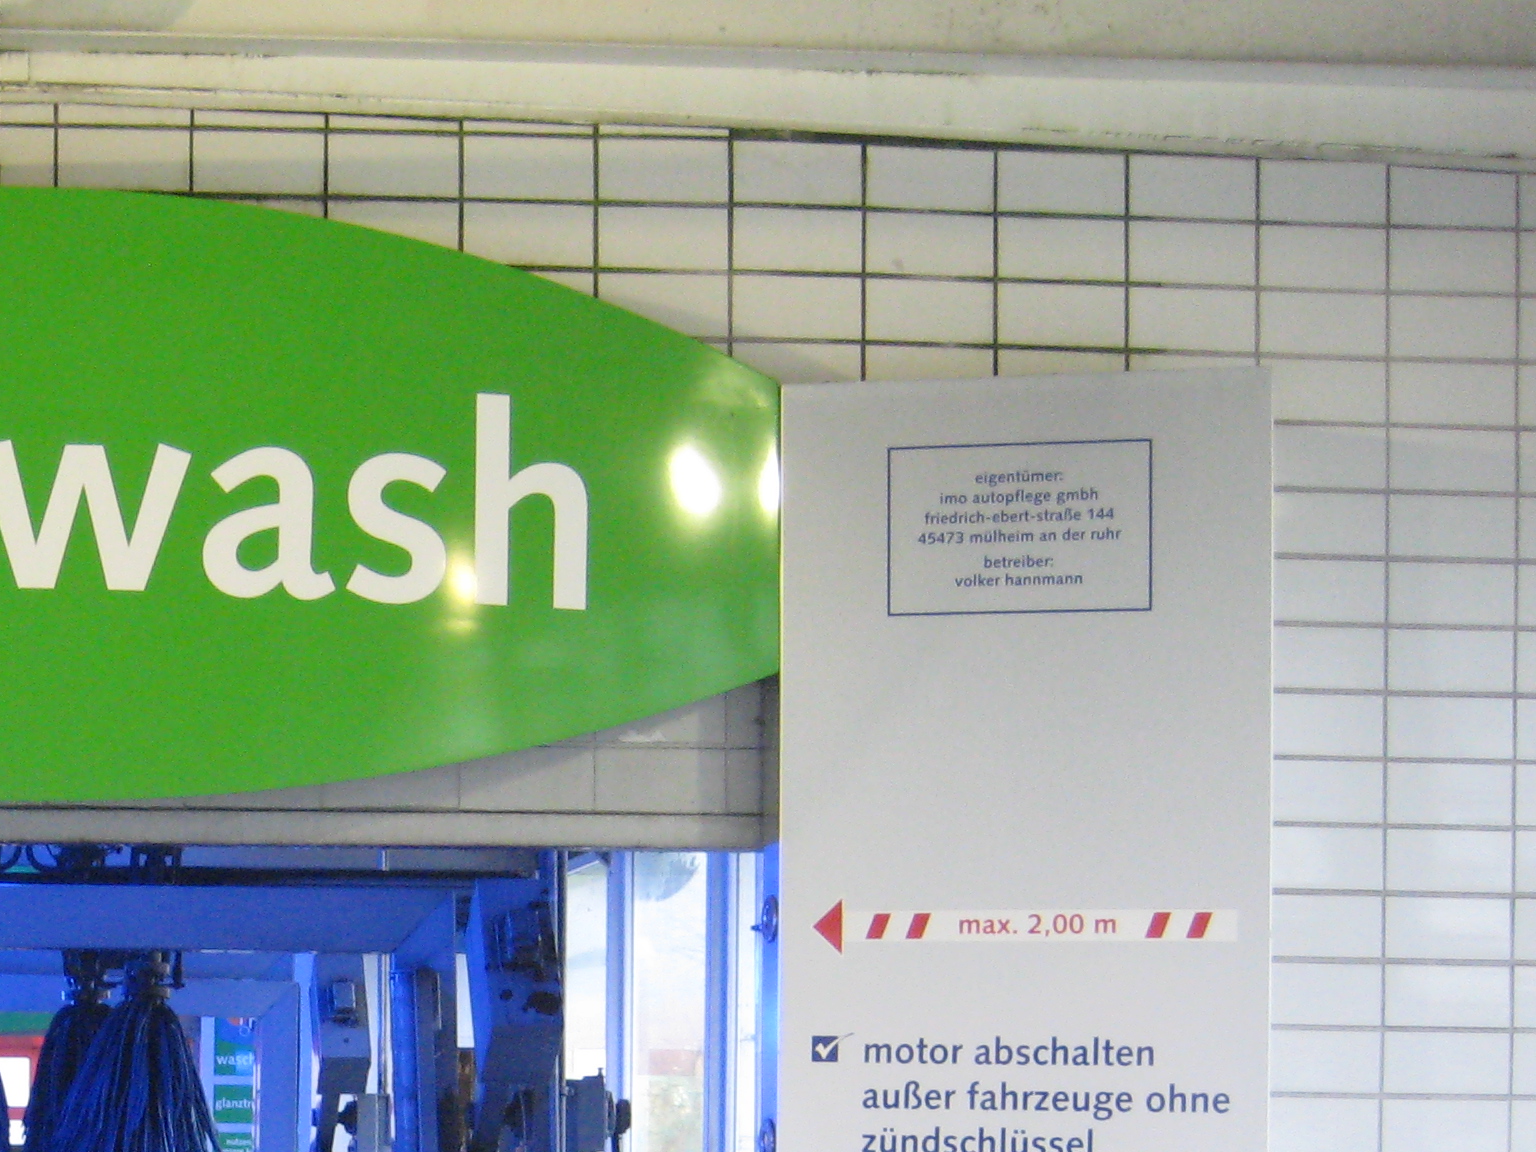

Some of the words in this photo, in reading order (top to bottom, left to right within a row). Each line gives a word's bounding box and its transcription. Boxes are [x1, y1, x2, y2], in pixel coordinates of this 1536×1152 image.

[975, 470, 1062, 487] eigentümer:
[940, 491, 968, 505] imo
[973, 489, 1051, 506] autopflege
[1056, 487, 1098, 505] gmbh
[925, 508, 1081, 524] friedrich-ebert-straße
[1088, 508, 1114, 519] 144
[918, 531, 964, 544] 45473
[970, 529, 1034, 543] mülheim
[1039, 532, 1056, 542] an
[1062, 527, 1085, 541] der
[1091, 527, 1121, 540] ruhr
[984, 555, 1053, 568] betreiber:
[955, 574, 1000, 587] volker
[1005, 573, 1083, 586] hannmann
[959, 919, 1017, 935] max.
[1028, 913, 1084, 936] 2,00
[1095, 919, 1116, 933] m
[865, 1038, 963, 1064] motor
[975, 1036, 1154, 1066] abschalten
[863, 1081, 955, 1109] außer
[967, 1081, 1132, 1120] fahrzeuge
[1146, 1084, 1230, 1113] ohne
